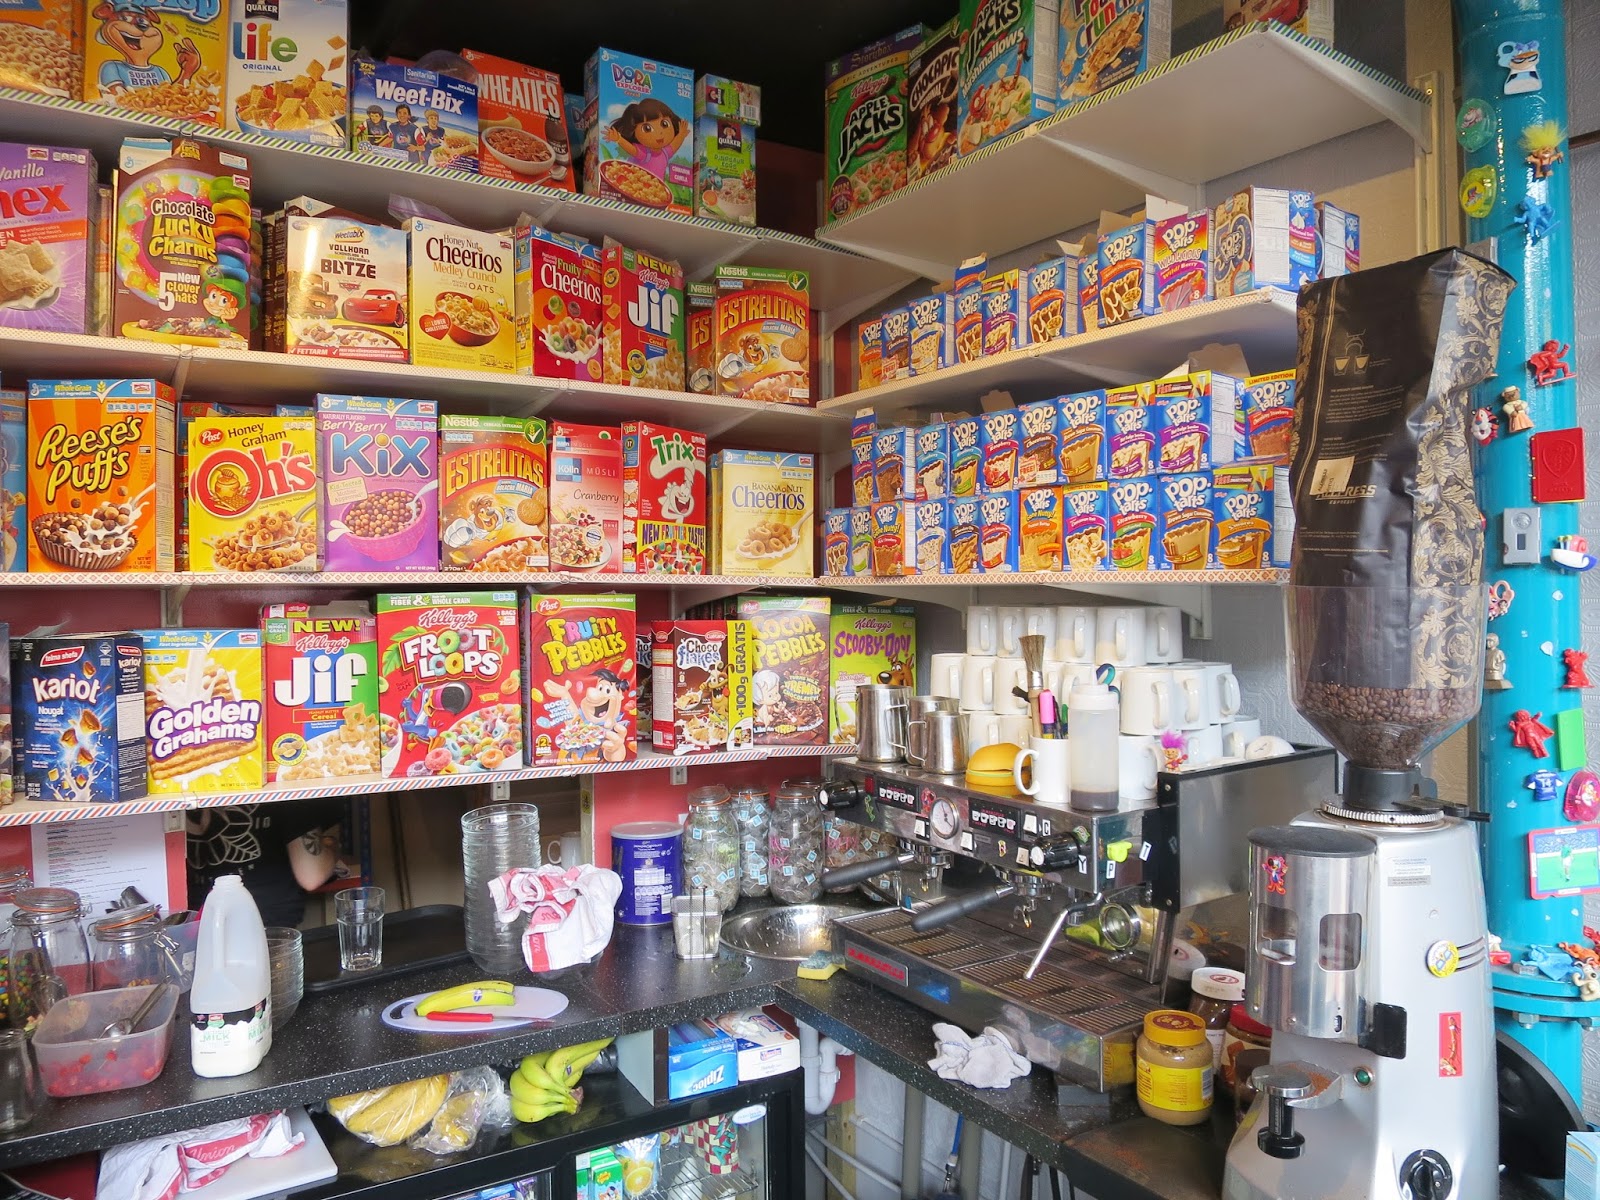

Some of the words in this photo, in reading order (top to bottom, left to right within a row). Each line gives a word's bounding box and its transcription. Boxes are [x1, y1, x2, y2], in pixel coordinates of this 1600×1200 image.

[247, 4, 278, 13] QUAKER
[966, 0, 1022, 76] JACKS
[129, 71, 157, 80] SUGAR
[242, 63, 282, 71] ORIGINAL
[407, 69, 437, 80] Sanitarium
[611, 62, 652, 89] DORA
[859, 57, 899, 76] ADVENTURES
[132, 78, 159, 87] BEAR
[617, 81, 651, 94] EXPLORER
[850, 74, 889, 99] Kellogg's
[375, 78, 464, 115] Weet-Bix
[477, 74, 561, 119] WHEATIES
[677, 89, 692, 99] SIZE
[851, 95, 889, 125] APPLE
[718, 137, 742, 147] QUAKER
[839, 103, 904, 173] JACKS
[151, 197, 216, 225] Chocolate
[151, 215, 217, 250] Lucky
[335, 229, 365, 239] weetabix
[443, 234, 466, 248] Honey
[466, 239, 479, 250] Nut
[149, 236, 218, 263] Charms
[1169, 233, 1194, 253] tarts
[425, 237, 503, 274] Cheerios
[433, 262, 464, 279] Medley
[467, 269, 497, 284] Crunch
[557, 257, 582, 279] Fruity
[636, 253, 677, 278] NEW!
[177, 272, 201, 285] New
[468, 282, 495, 294] OATS
[541, 263, 602, 305] Cheerios
[638, 268, 670, 291] Kellogg's
[158, 272, 178, 311] 5
[174, 291, 198, 305] hats
[627, 284, 679, 335] Jif
[719, 293, 807, 336] ESTRELITAS
[432, 318, 446, 326] LOWER
[296, 348, 328, 356] FETTARM
[1249, 375, 1270, 385] LIMITED
[1270, 372, 1295, 381] EDITION
[1157, 384, 1173, 394] FREE
[346, 399, 364, 407] Whole
[1258, 395, 1285, 411] tarts
[322, 420, 355, 431] Berry
[354, 422, 387, 433] Berry
[1027, 420, 1052, 437] tarts
[1069, 410, 1097, 428] tarts
[1171, 413, 1198, 429] tarts
[201, 429, 223, 443] Post
[227, 422, 264, 439] Honey
[241, 429, 287, 448] Graham
[36, 416, 143, 469] Reese's
[650, 432, 697, 467] Trix
[989, 441, 1011, 452] Raspberry
[46, 446, 131, 502] Puffs
[196, 440, 317, 519] Oh's
[445, 448, 545, 498] ESTRELITAS
[557, 464, 580, 474] Kölln
[586, 467, 616, 477] MÜSLI
[572, 488, 620, 504] Cranberry
[752, 482, 781, 491] BANANA
[786, 484, 804, 493] NUT
[731, 485, 806, 511] Cheerios
[1175, 493, 1206, 512] tarts
[921, 514, 940, 530] tarts
[1117, 513, 1148, 526] Strawberry
[1167, 516, 1180, 526] Brown
[1180, 513, 1192, 521] Sugar
[1192, 510, 1213, 518] Cinnamon
[1231, 506, 1257, 522] tarts
[642, 523, 660, 545] NEW
[661, 523, 688, 541] FRUITIER
[688, 526, 706, 549] TASTE!
[539, 600, 559, 612] Post
[742, 602, 758, 611] Post
[293, 620, 361, 633] NEW!
[418, 607, 478, 629] Kellogg's
[752, 614, 816, 640] COCOA
[854, 617, 892, 633] Kellogg's
[545, 616, 617, 643] FRUITY
[295, 634, 350, 654] Kellogg's
[402, 628, 492, 664] FROOT
[541, 631, 627, 676] PEBBLES
[686, 640, 719, 653] Choco
[752, 631, 826, 670] PEBBLES
[833, 631, 912, 658] SCOOBY-DOO!
[118, 656, 141, 669] kariot
[418, 651, 500, 678] LOOPS
[678, 645, 720, 667] flakes
[32, 673, 101, 704] kariot
[274, 653, 368, 706] Jif
[38, 706, 65, 717] Nougat
[544, 699, 571, 711] ROCKS
[549, 710, 572, 719] WHOLE
[150, 699, 260, 740] Golden
[311, 713, 337, 721] Cereal
[154, 722, 256, 759] Grahams
[203, 1032, 230, 1042] MILK
[691, 1064, 725, 1093] Ziploc
